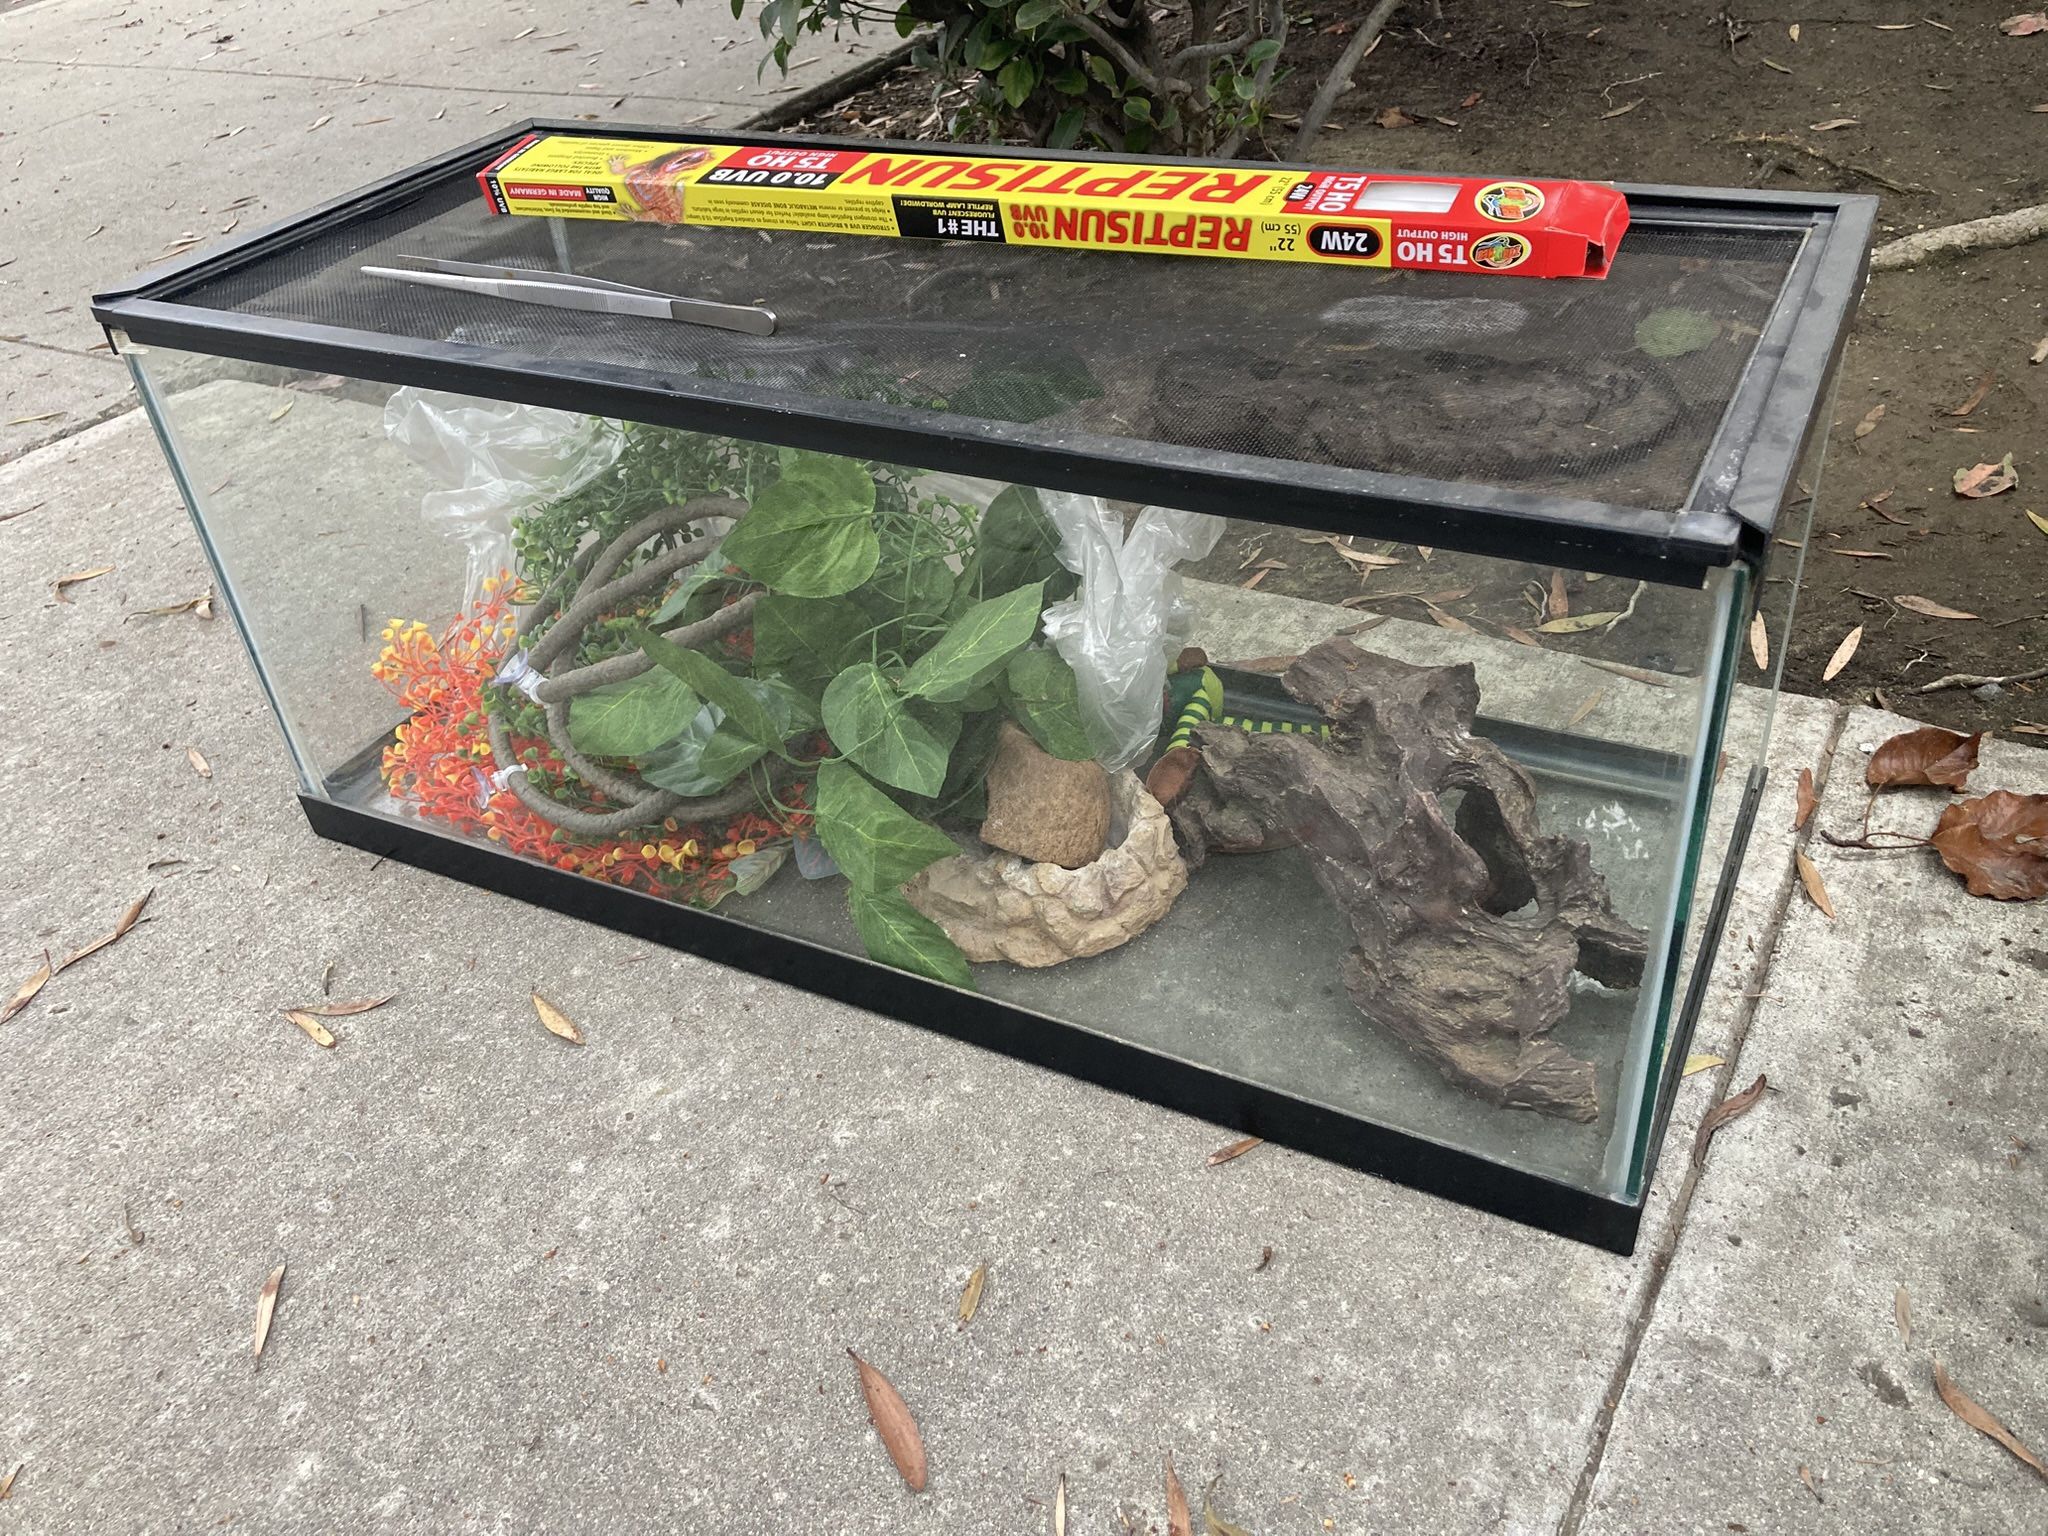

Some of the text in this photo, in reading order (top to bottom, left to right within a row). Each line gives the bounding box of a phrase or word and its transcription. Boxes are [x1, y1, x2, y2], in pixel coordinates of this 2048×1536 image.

[747, 155, 832, 169] T5 HO
[709, 169, 828, 185] 10.0 UVB
[840, 158, 1271, 203] REPTISUN
[1318, 176, 1367, 211] T5 HO
[497, 198, 507, 213] UVB
[900, 200, 944, 208] WORLDWIDE!
[948, 210, 995, 218] FLUORESCENT
[1010, 204, 1048, 222] UVB
[938, 218, 999, 236] THE #1
[1014, 222, 1050, 239] 10.0
[1054, 208, 1252, 252] REPTISUN
[1261, 221, 1301, 235] (55 cm)
[1397, 229, 1468, 241] HIGH OUTPUT
[1321, 230, 1368, 252] 24W
[1397, 241, 1468, 264] T5 HO
